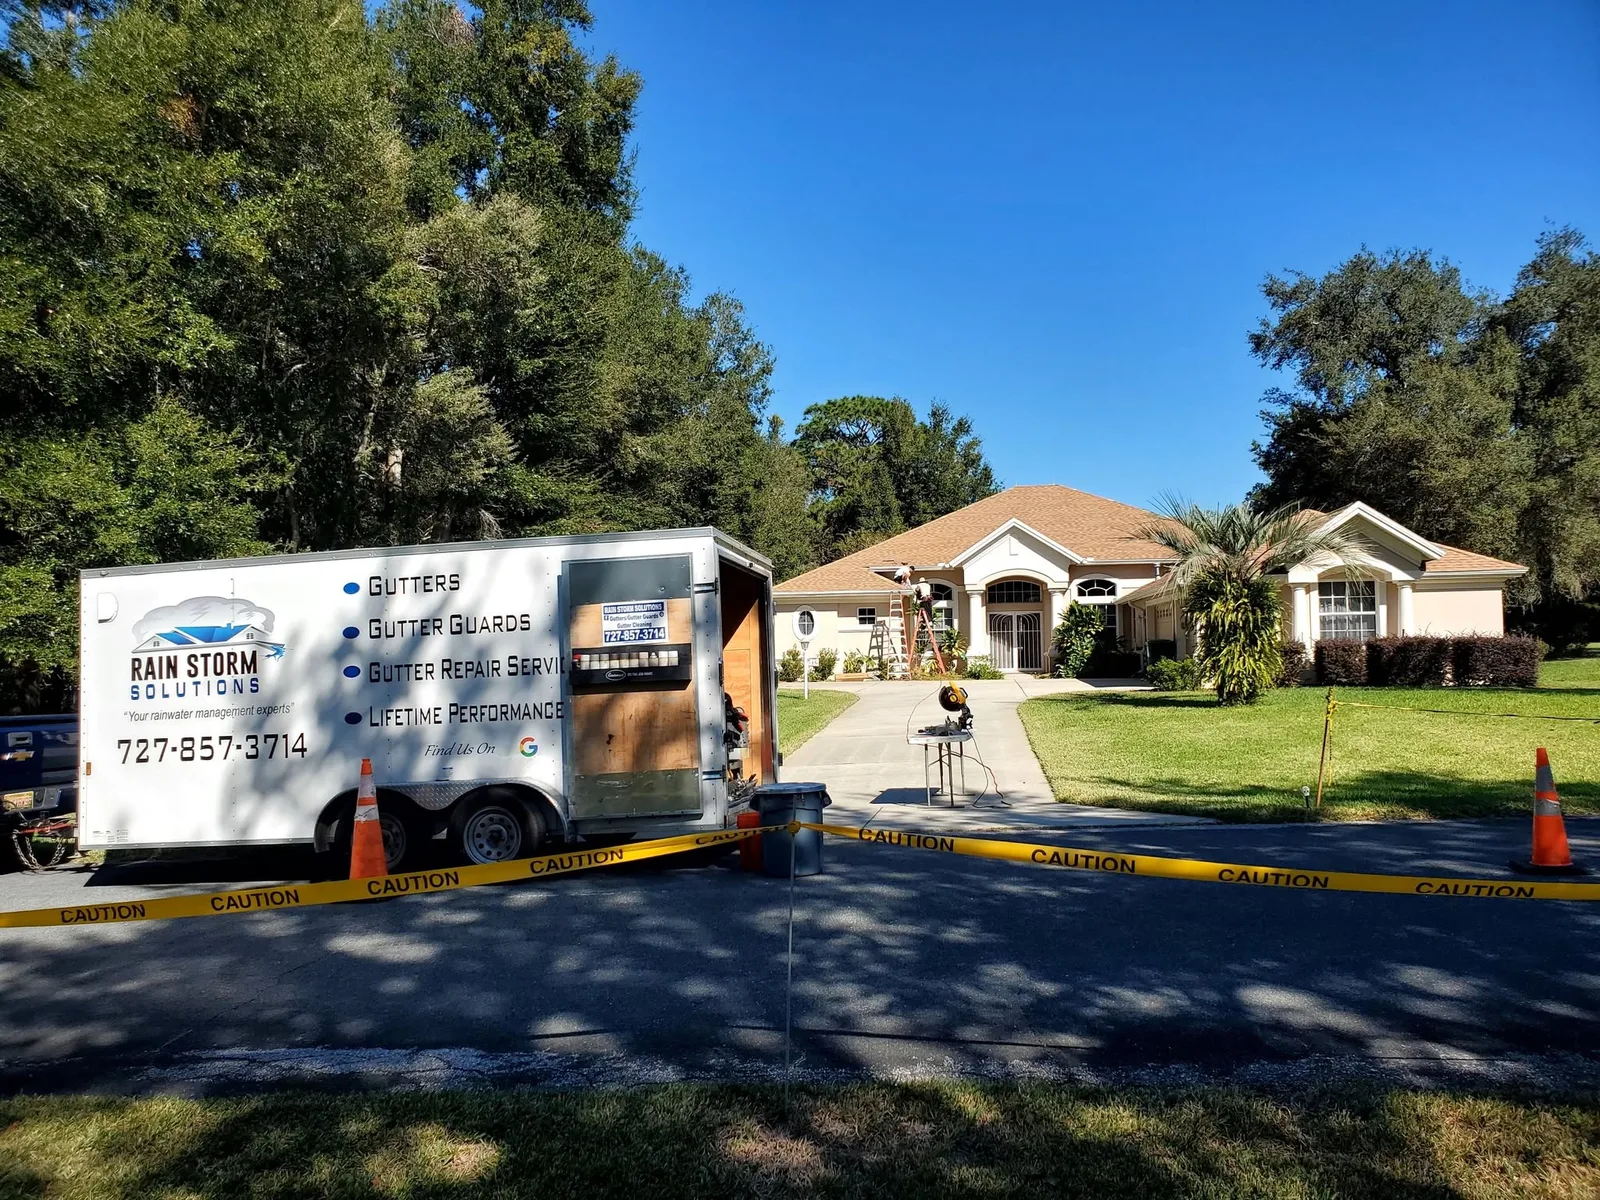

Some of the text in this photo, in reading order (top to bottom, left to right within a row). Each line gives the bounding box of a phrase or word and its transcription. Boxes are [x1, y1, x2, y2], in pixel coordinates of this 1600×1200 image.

[604, 603, 662, 614] RAIN STORM SOLUTIONS
[604, 628, 665, 642] 727-857-3714
[131, 650, 258, 681] RAIN STORM
[130, 678, 259, 700] SOLUTIONS
[150, 708, 193, 721] rainwater
[195, 705, 254, 720] management
[117, 732, 308, 765] 727-857-3714
[424, 742, 496, 757] Find Us On
[519, 736, 539, 758] G
[858, 828, 1535, 899] CAUTION CAUTION CAUTION CAUTION
[60, 904, 146, 924] CAUTION
[210, 889, 300, 912] CAUTION
[367, 871, 460, 897] CAUTION
[530, 849, 624, 875] CAUTION
